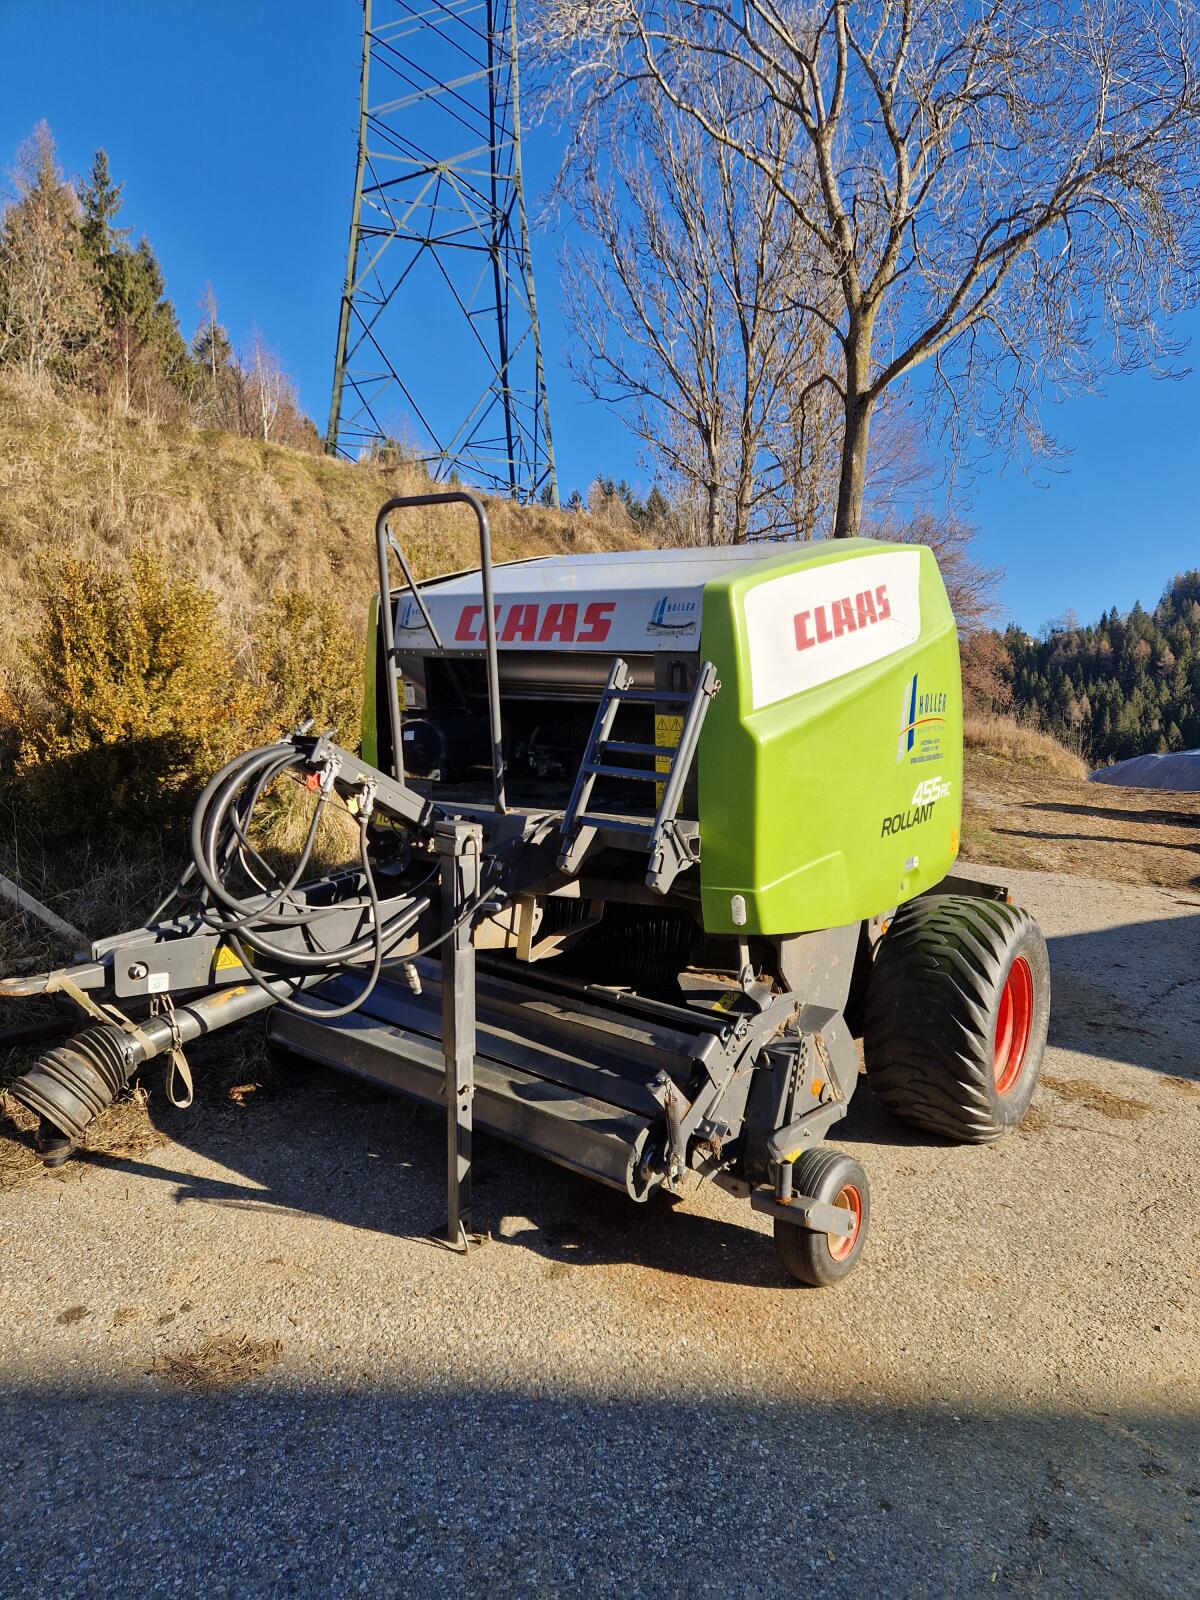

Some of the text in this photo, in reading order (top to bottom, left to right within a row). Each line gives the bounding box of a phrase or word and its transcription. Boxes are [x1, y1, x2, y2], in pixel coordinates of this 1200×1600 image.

[454, 602, 617, 642] CLAAS
[794, 584, 891, 651] CLAAS
[918, 693, 946, 715] HOLLER
[881, 801, 935, 838] ROLLANT
